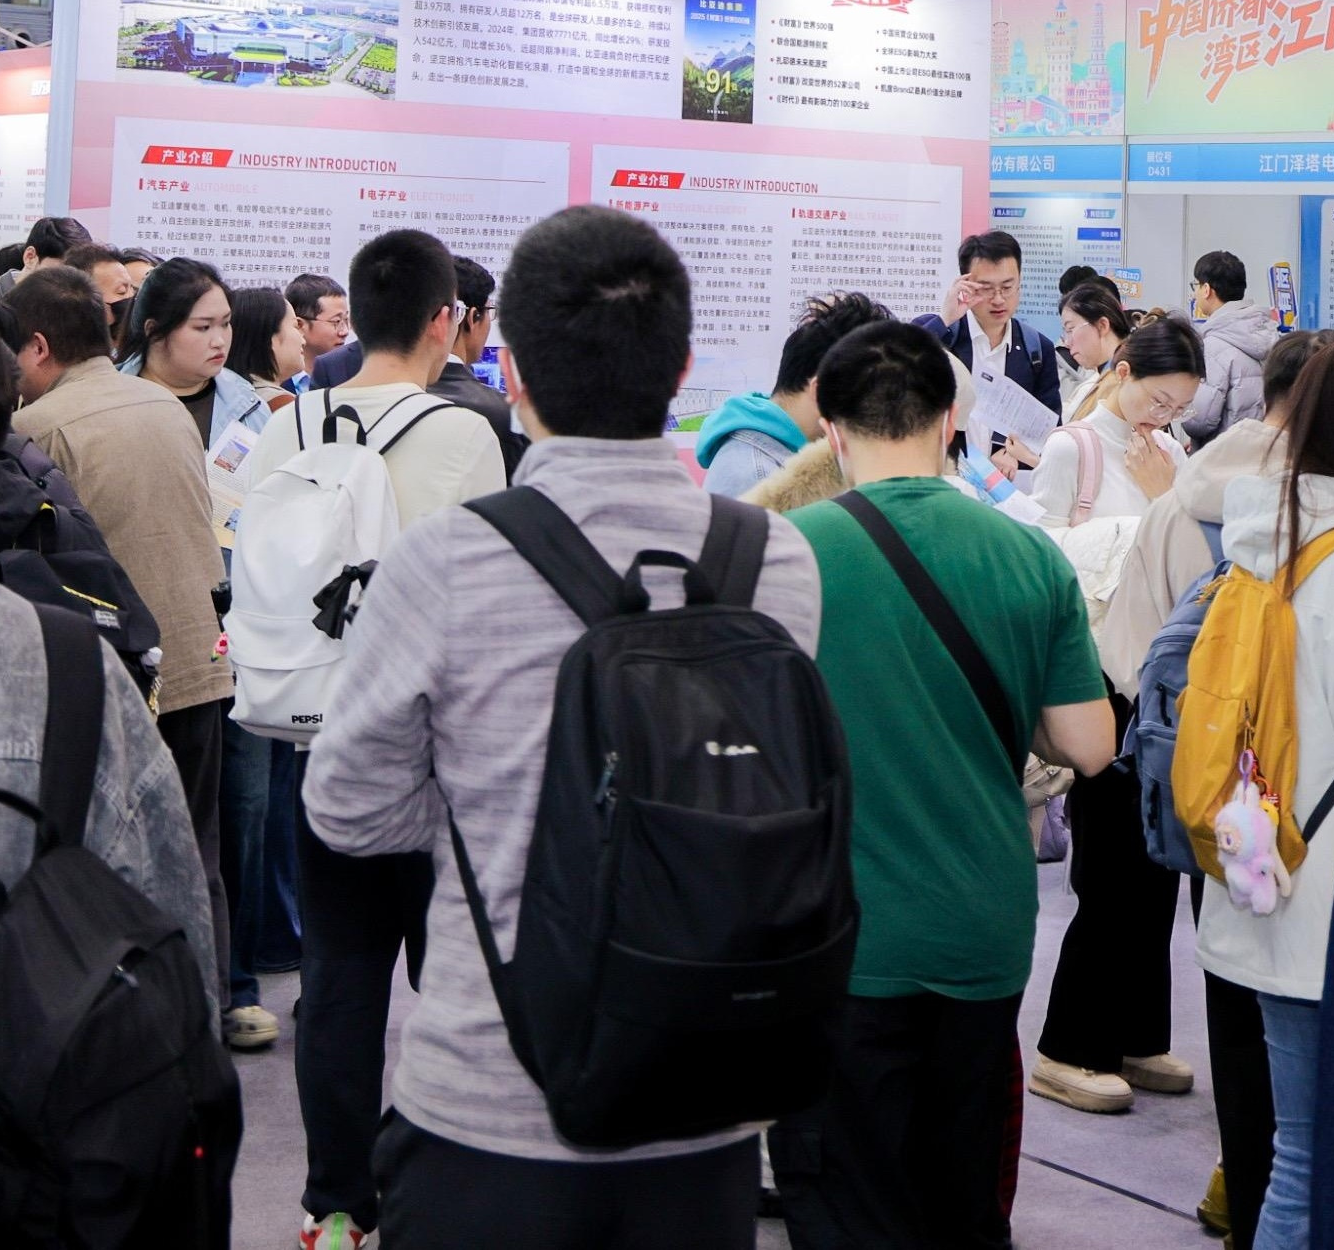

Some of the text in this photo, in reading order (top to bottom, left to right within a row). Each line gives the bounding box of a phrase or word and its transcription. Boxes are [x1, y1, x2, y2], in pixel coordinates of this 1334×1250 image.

[1202, 31, 1267, 102] 湾区
[162, 149, 397, 172] 产业介绍 INDUSTRY INTRODUCTION
[992, 155, 1055, 172] 份有限公司
[1148, 166, 1171, 177] D431
[147, 179, 189, 192] 汽车产业
[627, 173, 818, 194] 产业介绍 INDUSTRY INTRODUCTION
[368, 190, 407, 201] 电子产业
[798, 209, 846, 220] 轨道交通产业
